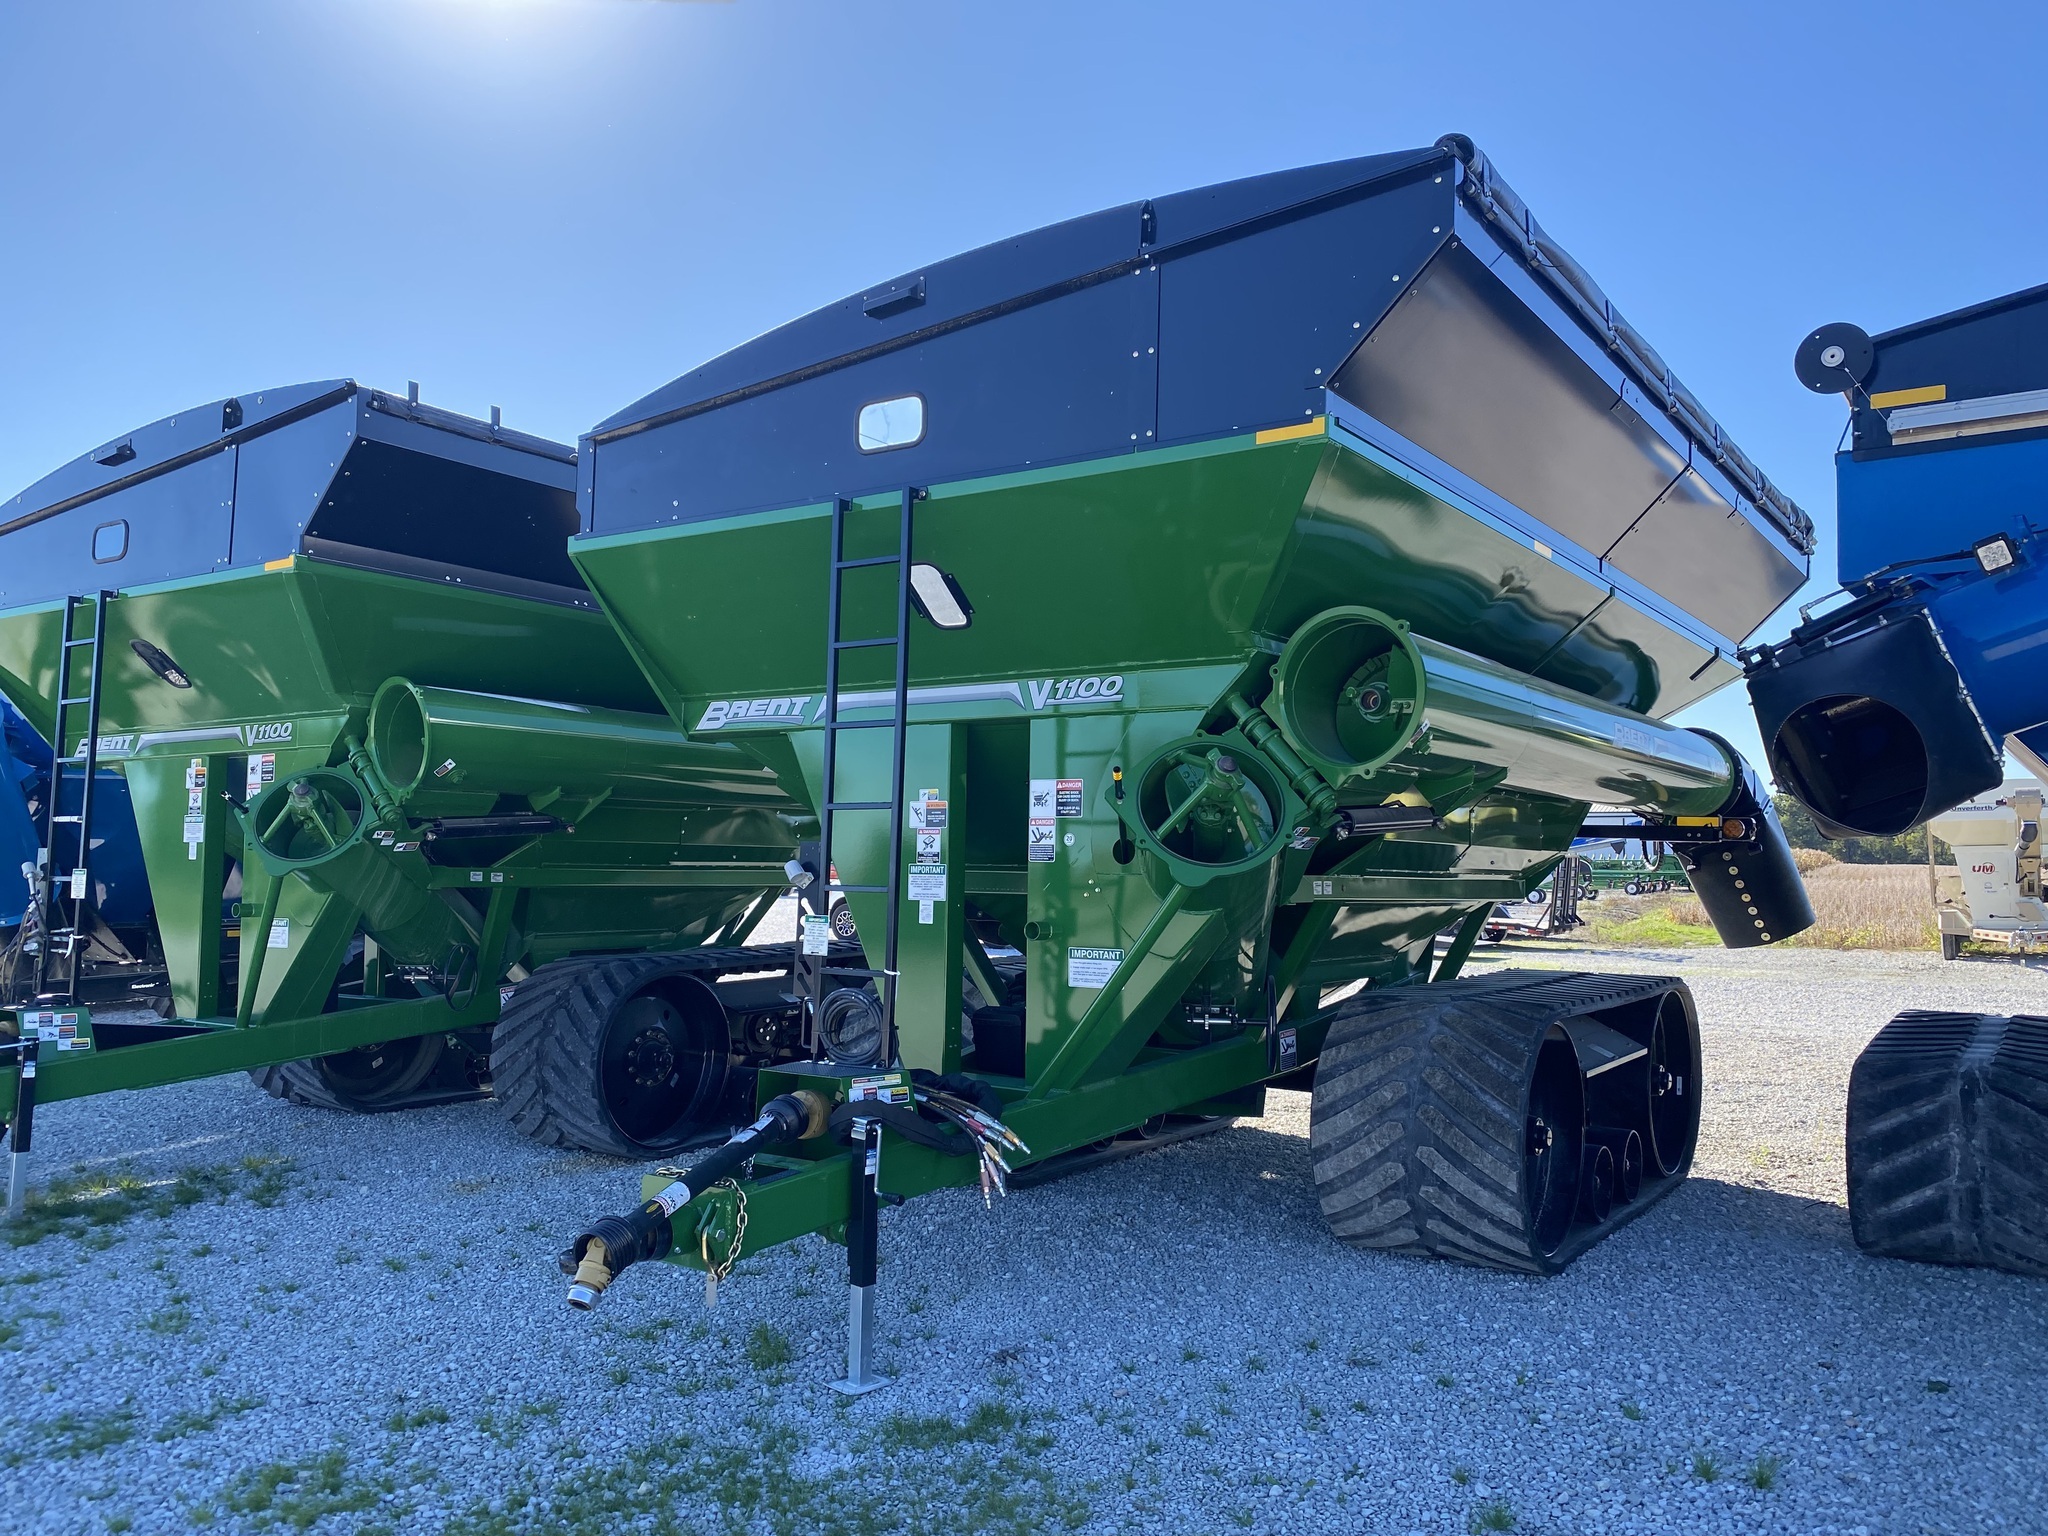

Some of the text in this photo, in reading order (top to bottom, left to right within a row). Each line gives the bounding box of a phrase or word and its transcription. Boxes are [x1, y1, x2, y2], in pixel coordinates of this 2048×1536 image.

[1028, 675, 1125, 710] V1100
[695, 697, 812, 731] BRENT
[245, 722, 293, 747] V1100
[910, 865, 945, 874] IMPORTANT
[1071, 949, 1121, 960] IMPORTANT
